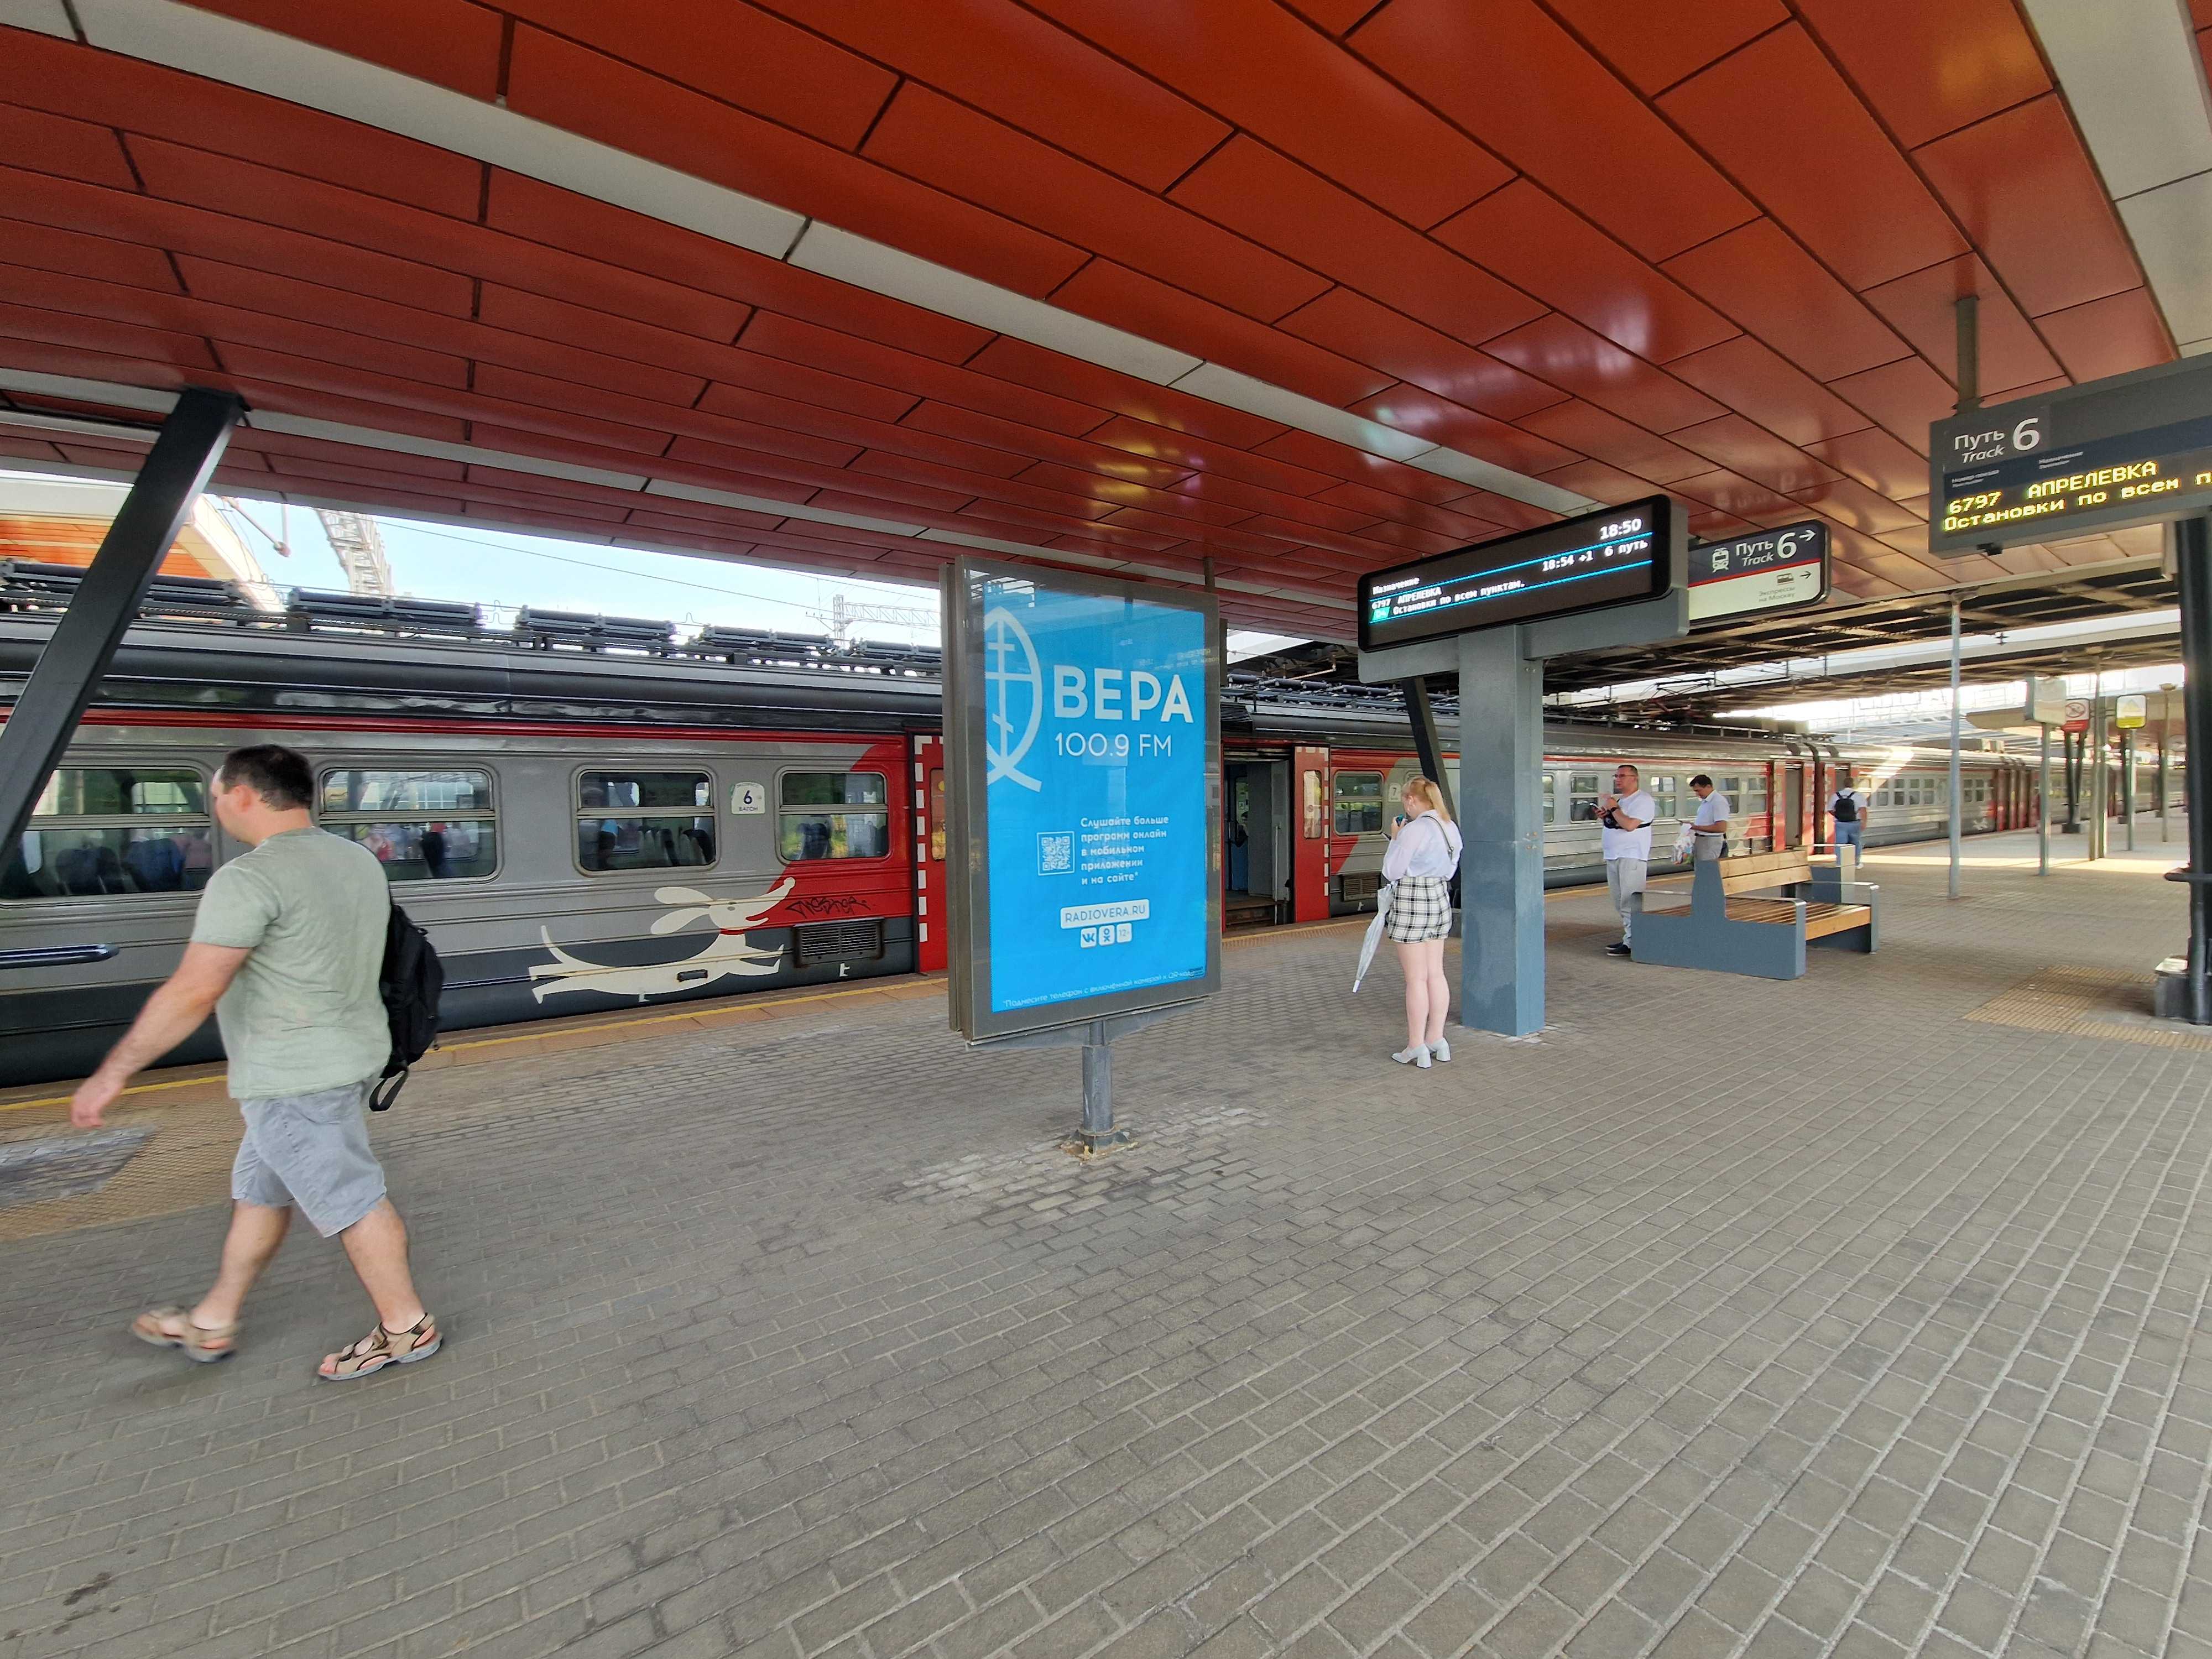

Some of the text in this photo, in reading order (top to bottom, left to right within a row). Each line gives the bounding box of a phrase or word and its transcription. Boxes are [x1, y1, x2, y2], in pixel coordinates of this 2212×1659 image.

[1954, 418, 2041, 451] Путь 6
[1962, 445, 2005, 463] Track
[1949, 461, 2157, 514] 6797 АПРЕЛЕВКА
[1943, 499, 2065, 531] Остановки
[2078, 491, 2107, 507] по
[2120, 477, 2180, 499] всем
[1599, 518, 1642, 540] 18:50
[1735, 532, 1797, 559] Путь 6
[1741, 552, 1775, 567] Track
[1371, 540, 1648, 610] 6797 АПРЕЛЕВКА 18:54 +1 6 путь
[1439, 596, 1452, 605] по
[1454, 590, 1478, 602] всем
[1479, 580, 1525, 596] пунктам.
[1053, 664, 1194, 723] ВЕРА
[1055, 732, 1172, 757] 100.9 FM
[743, 790, 753, 805] 6
[1081, 816, 1169, 829] Слушайте больше
[1081, 829, 1167, 843] программ онлайн
[1090, 846, 1145, 855] мобильном
[1081, 859, 1144, 872] приложении
[1065, 905, 1146, 922] RADIOVERA.RU
